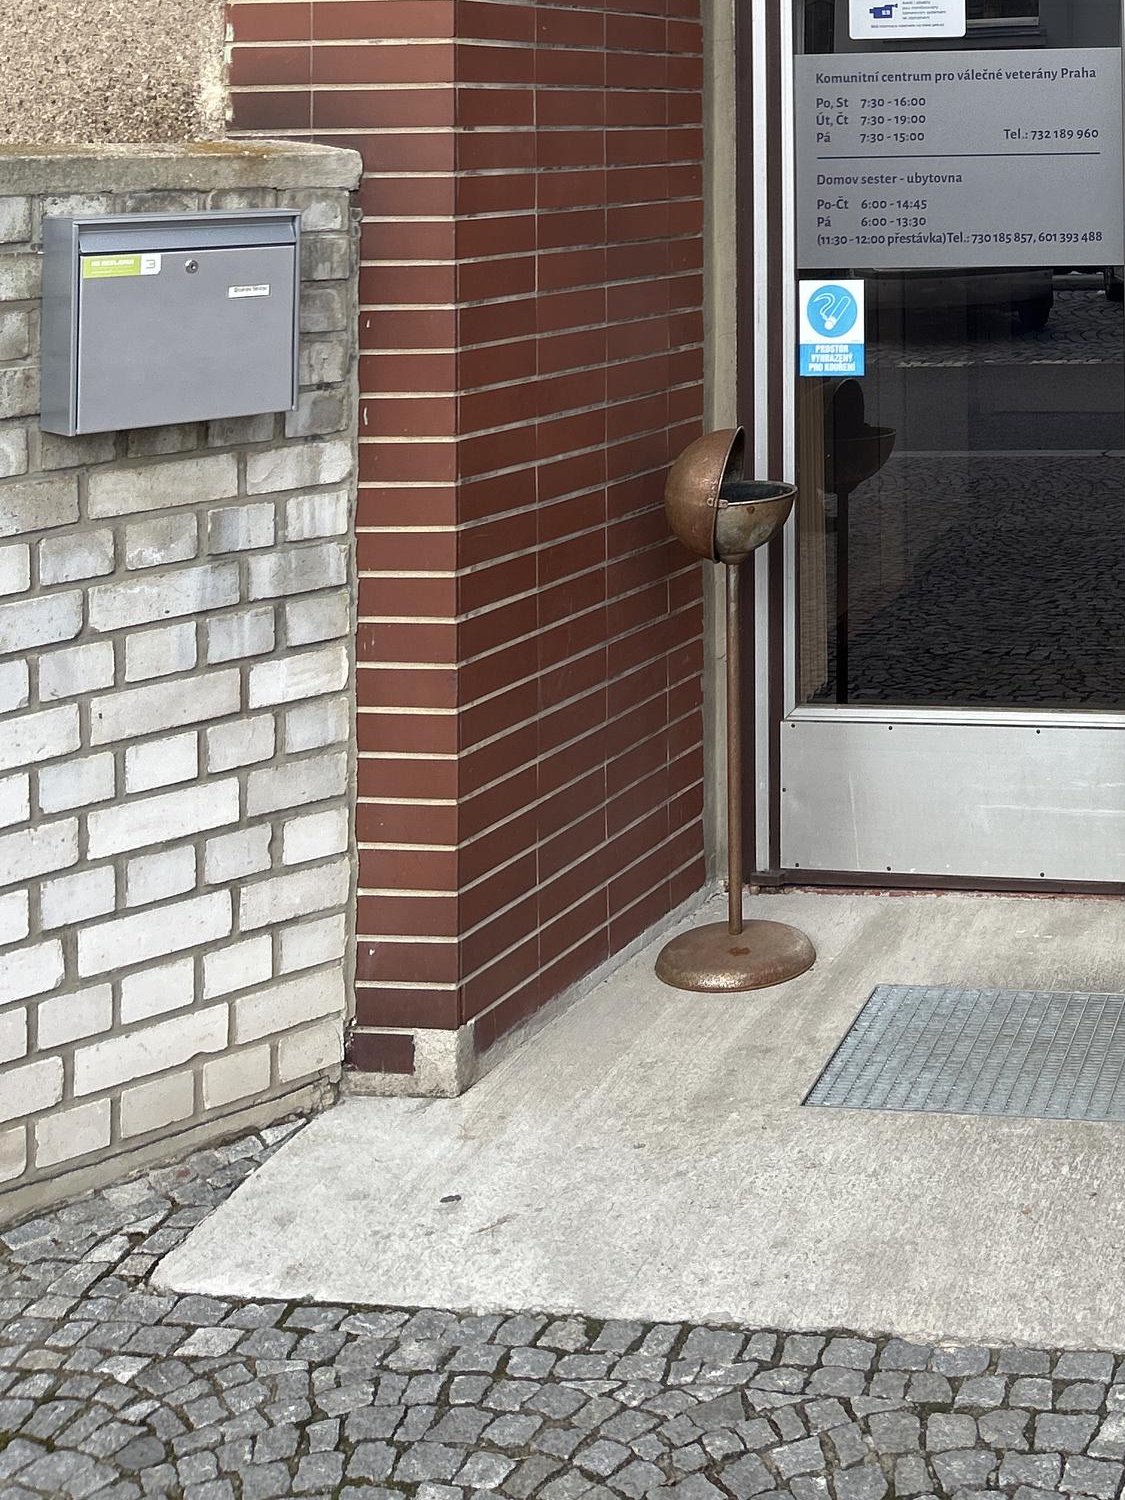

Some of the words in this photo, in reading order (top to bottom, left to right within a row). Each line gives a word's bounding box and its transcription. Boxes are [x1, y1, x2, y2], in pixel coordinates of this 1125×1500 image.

[815, 71, 879, 84] Komunitní
[881, 71, 932, 83] centrum
[934, 71, 955, 84] pro
[957, 68, 1003, 81] válečné
[1005, 68, 1058, 81] veterány
[1060, 67, 1097, 79] Praha
[816, 98, 834, 109] Po,
[836, 97, 849, 108] St
[860, 98, 885, 109] 7:30
[894, 97, 926, 107] 16:00
[816, 112, 834, 127] Út,
[836, 112, 849, 126] Čt
[860, 116, 885, 126] 7:30
[893, 115, 926, 125] 19:00
[816, 131, 831, 143] Pá
[859, 133, 885, 144] 7:30
[893, 132, 925, 143] 15:00
[1030, 130, 1051, 141] 732
[1053, 129, 1074, 140] 189
[1076, 128, 1099, 139] 960
[816, 174, 859, 186] Domov
[861, 174, 898, 185] sester
[906, 172, 963, 186] ubytovna
[816, 196, 849, 210] Po-Čt
[860, 199, 887, 210] 6:00
[896, 199, 928, 210] 14:45
[816, 216, 832, 228] Pá
[860, 217, 887, 227] 6:00
[896, 217, 927, 228] 13:30
[817, 234, 848, 247] (11:30
[855, 234, 886, 245] 12:00
[971, 233, 992, 244] 730
[994, 232, 1012, 244] 185
[1013, 232, 1036, 244] 857,
[1038, 231, 1057, 242] 601
[1060, 232, 1079, 243] 393
[1081, 231, 1103, 242] 488
